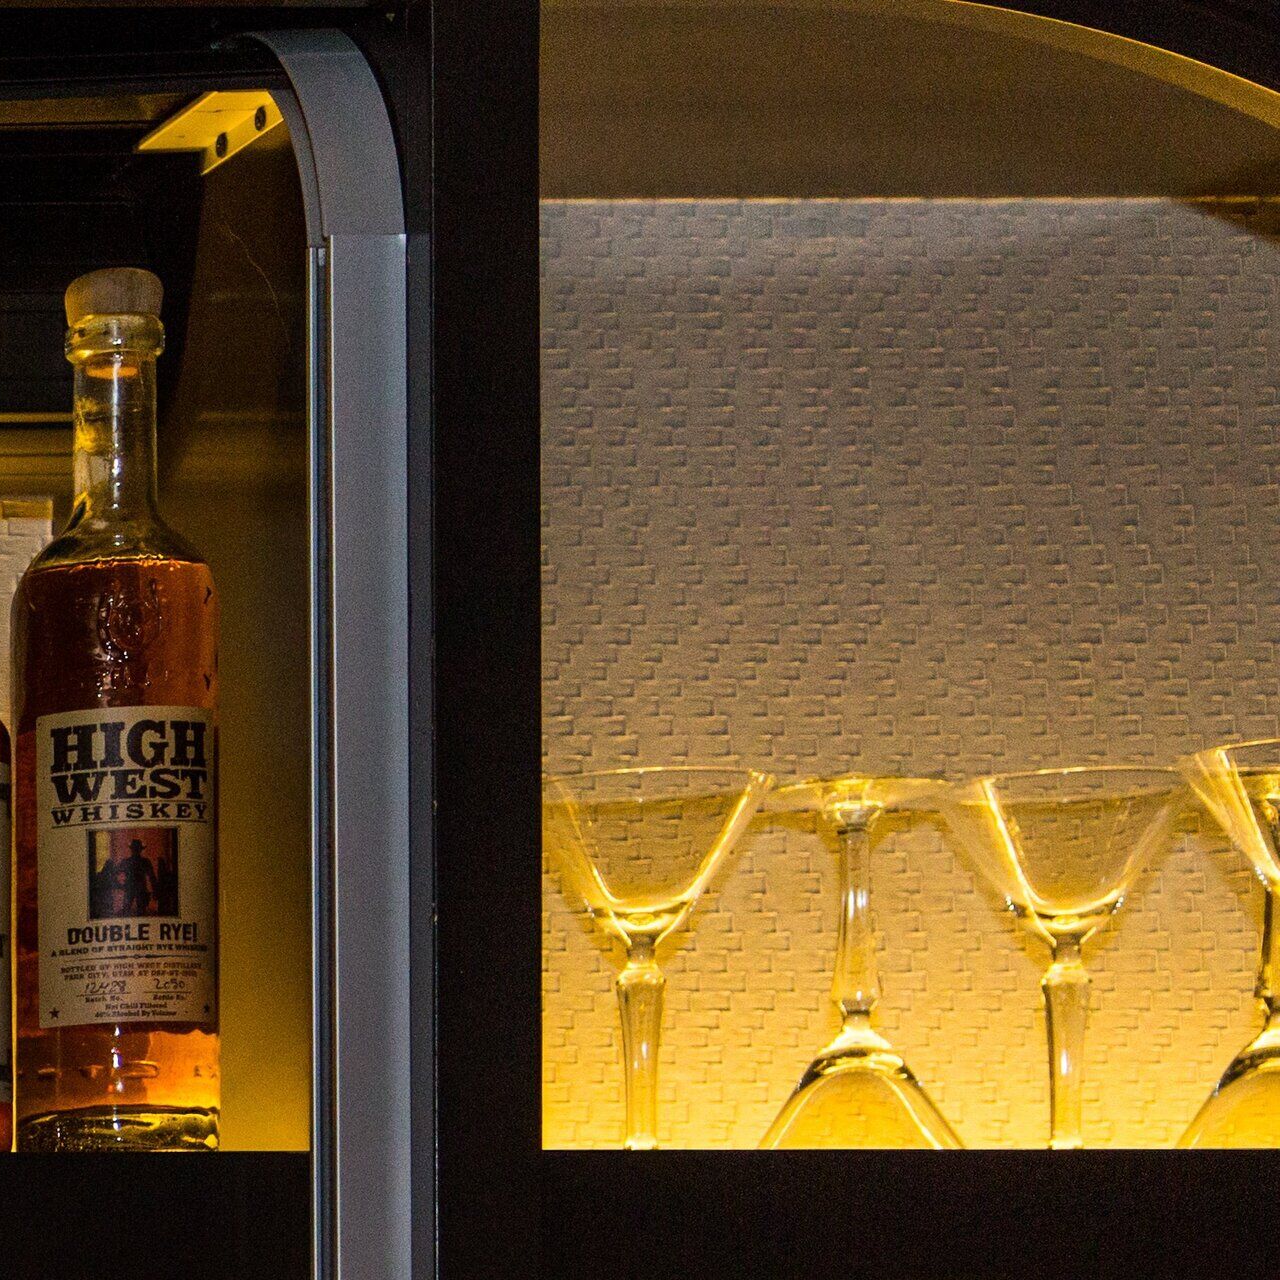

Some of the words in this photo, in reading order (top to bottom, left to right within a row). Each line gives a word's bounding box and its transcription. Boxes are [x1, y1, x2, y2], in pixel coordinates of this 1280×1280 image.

[50, 719, 207, 773] HIGH
[50, 768, 208, 806] WEST
[51, 802, 208, 825] WHISKEY
[67, 922, 151, 946] DOUBLE
[159, 921, 198, 942] RYE!
[59, 947, 90, 957] BLEND
[91, 945, 106, 954] OF
[107, 943, 154, 953] STRAIGHT
[156, 943, 174, 951] RYE
